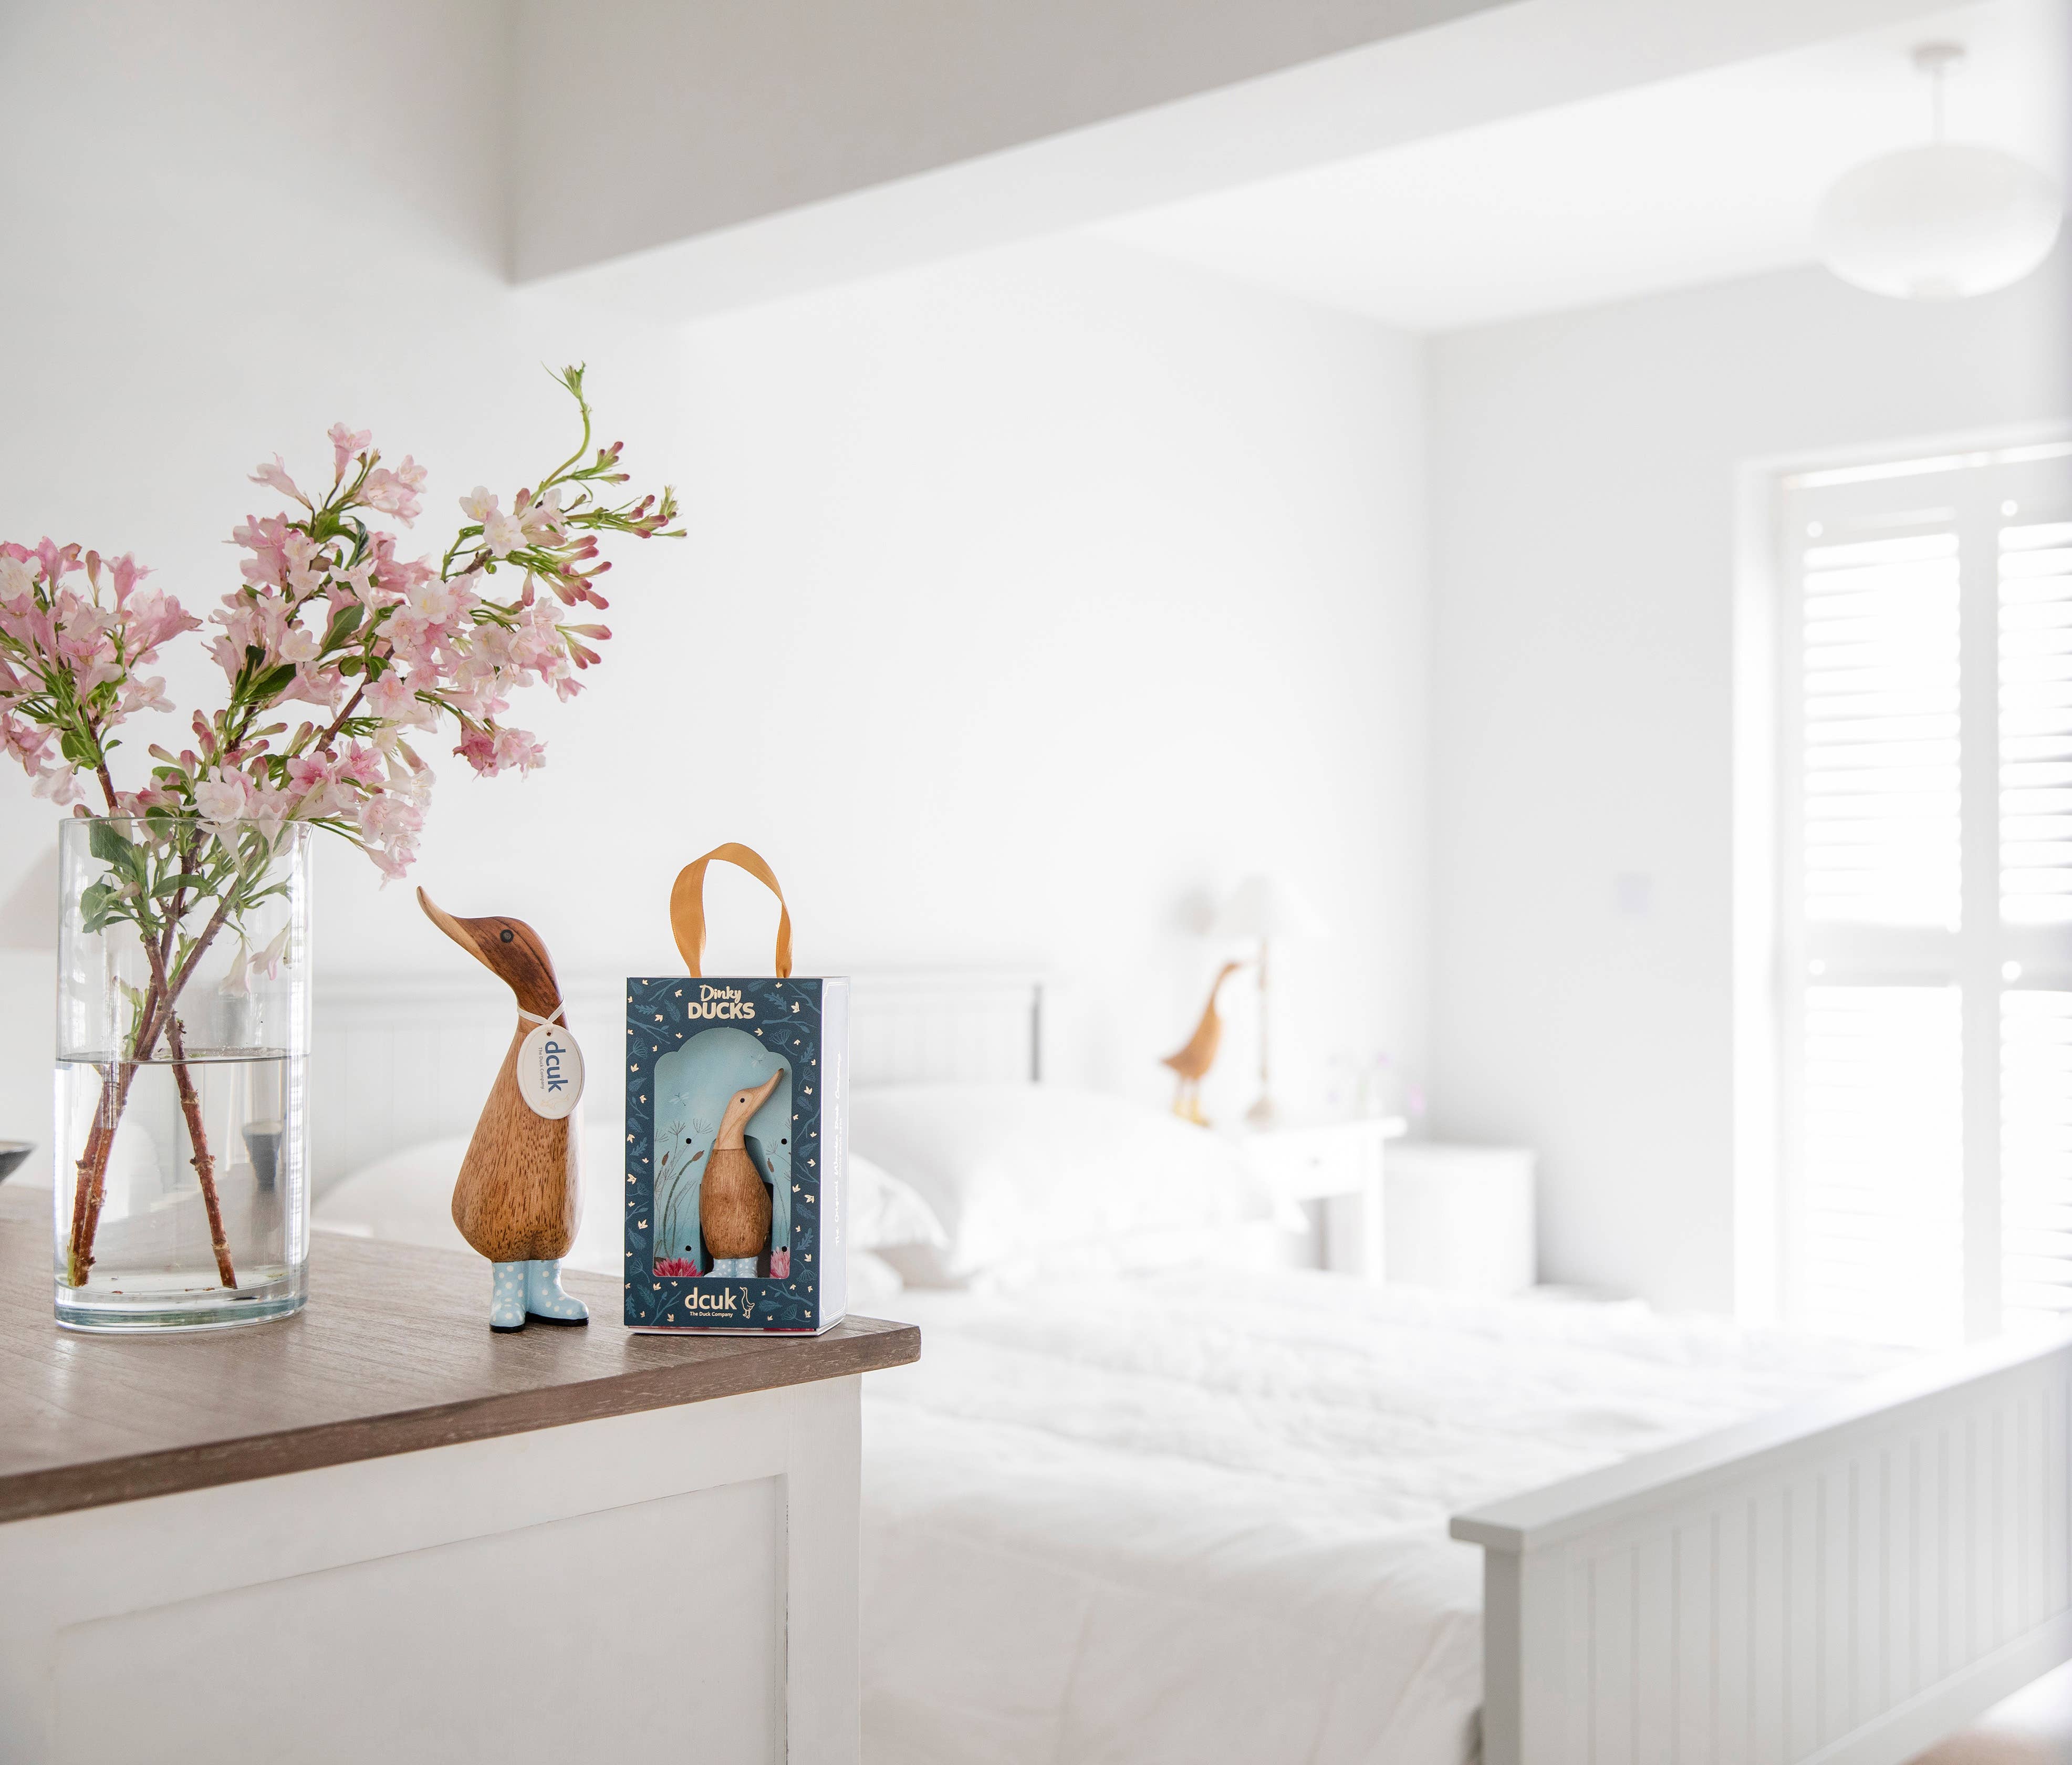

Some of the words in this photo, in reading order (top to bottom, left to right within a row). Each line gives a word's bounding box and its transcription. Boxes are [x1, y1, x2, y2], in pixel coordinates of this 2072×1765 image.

[700, 984, 741, 1003] Dinky
[688, 1002, 755, 1019] DUCKS
[545, 1041, 568, 1093] dcuk
[685, 1286, 737, 1310] dcuk
